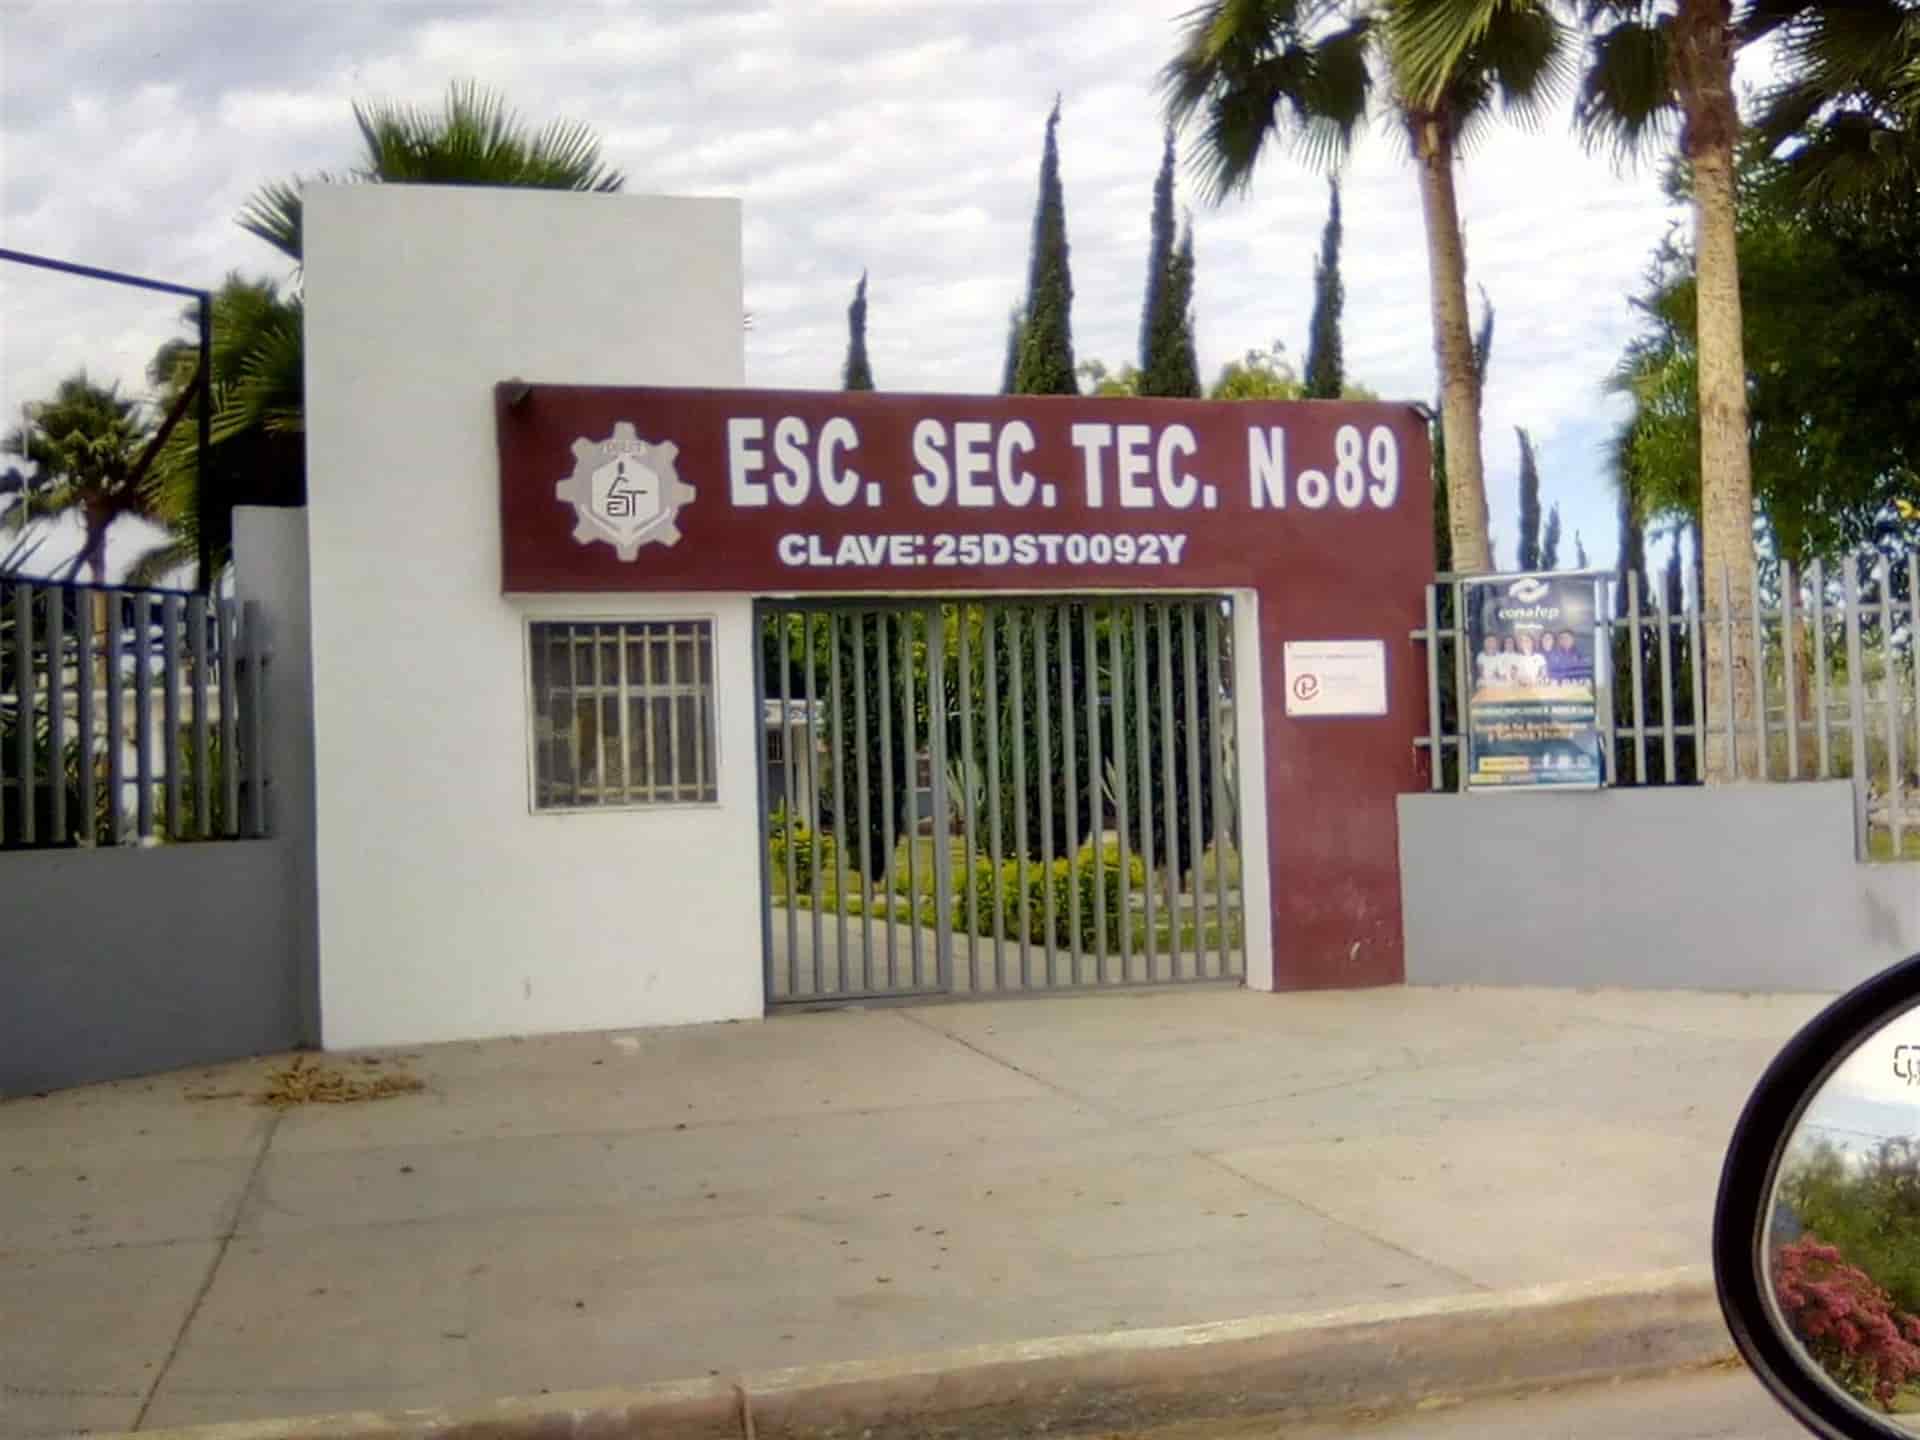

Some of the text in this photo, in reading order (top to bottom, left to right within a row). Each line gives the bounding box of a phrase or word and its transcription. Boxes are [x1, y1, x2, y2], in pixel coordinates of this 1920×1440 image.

[727, 416, 881, 507] ESC.
[912, 418, 1057, 508] SEC.
[1071, 422, 1217, 509] TEC.
